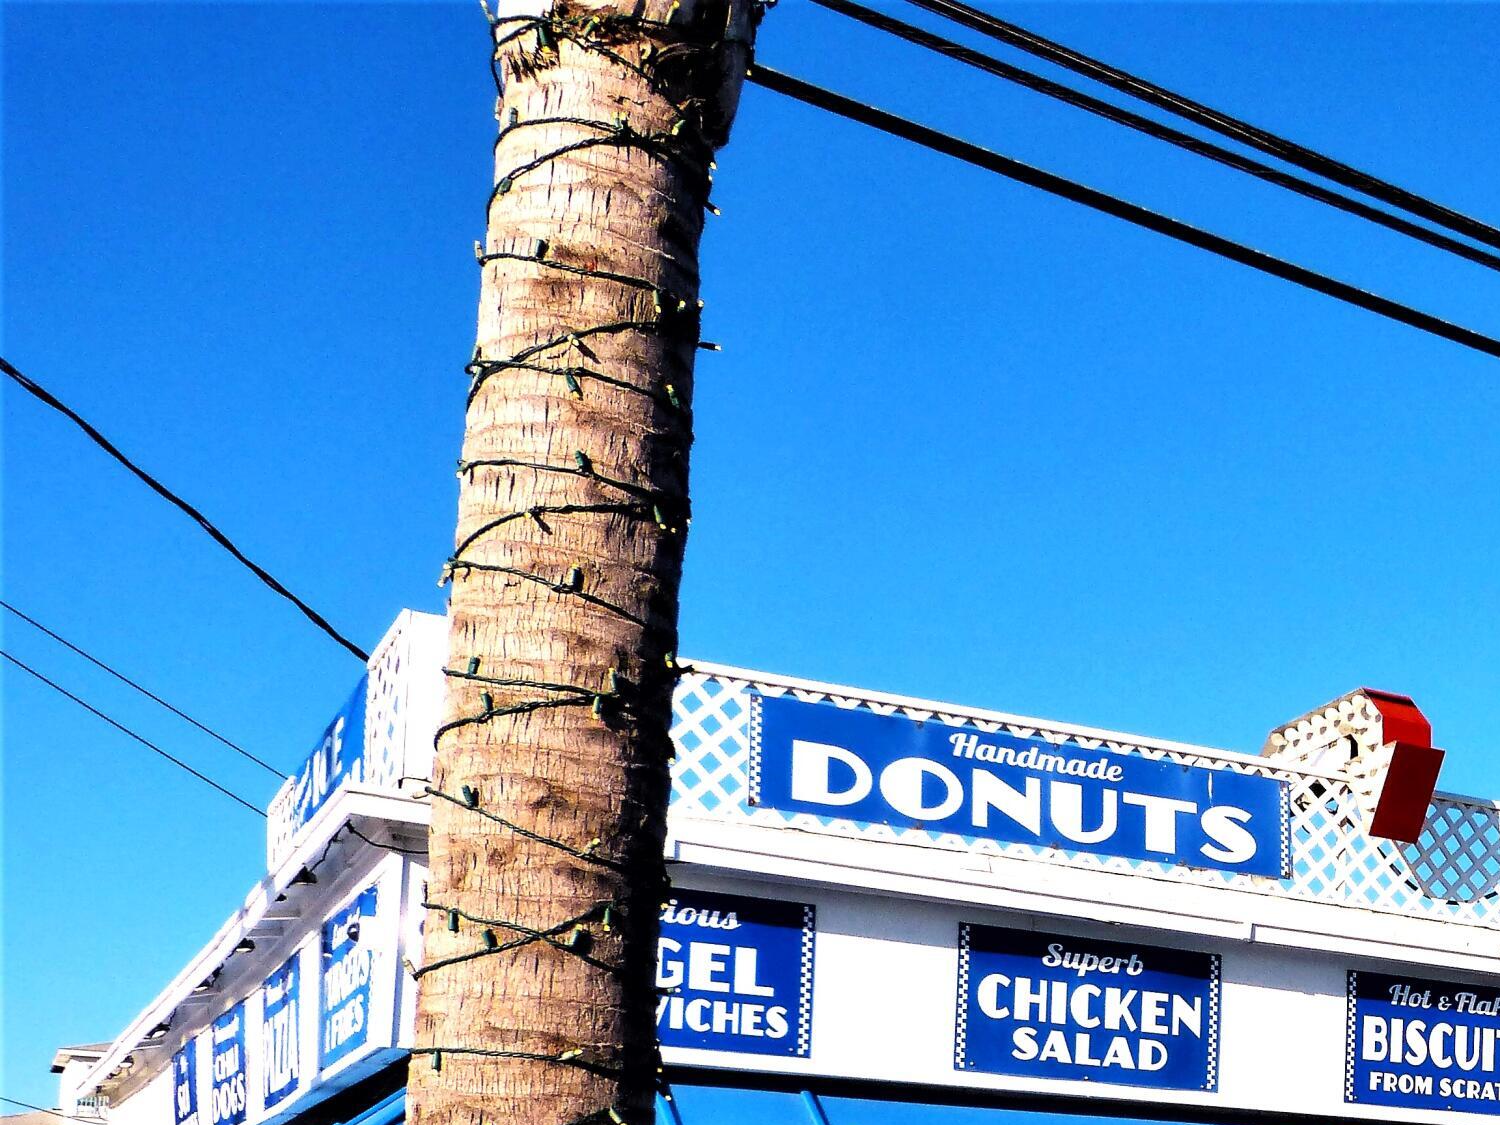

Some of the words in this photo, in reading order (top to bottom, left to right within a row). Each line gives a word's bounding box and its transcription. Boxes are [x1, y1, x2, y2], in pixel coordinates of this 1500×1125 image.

[948, 732, 1124, 783] Handmade
[791, 739, 1258, 864] DONUTS
[658, 899, 742, 930] ious
[655, 937, 775, 998] GEL
[1042, 942, 1144, 977] Superb
[977, 972, 1203, 1039] CHICKEN
[1389, 984, 1432, 1011] Hot
[1438, 993, 1452, 1012] &
[1012, 1026, 1168, 1072] SALAD
[1369, 1070, 1433, 1095] FROM
